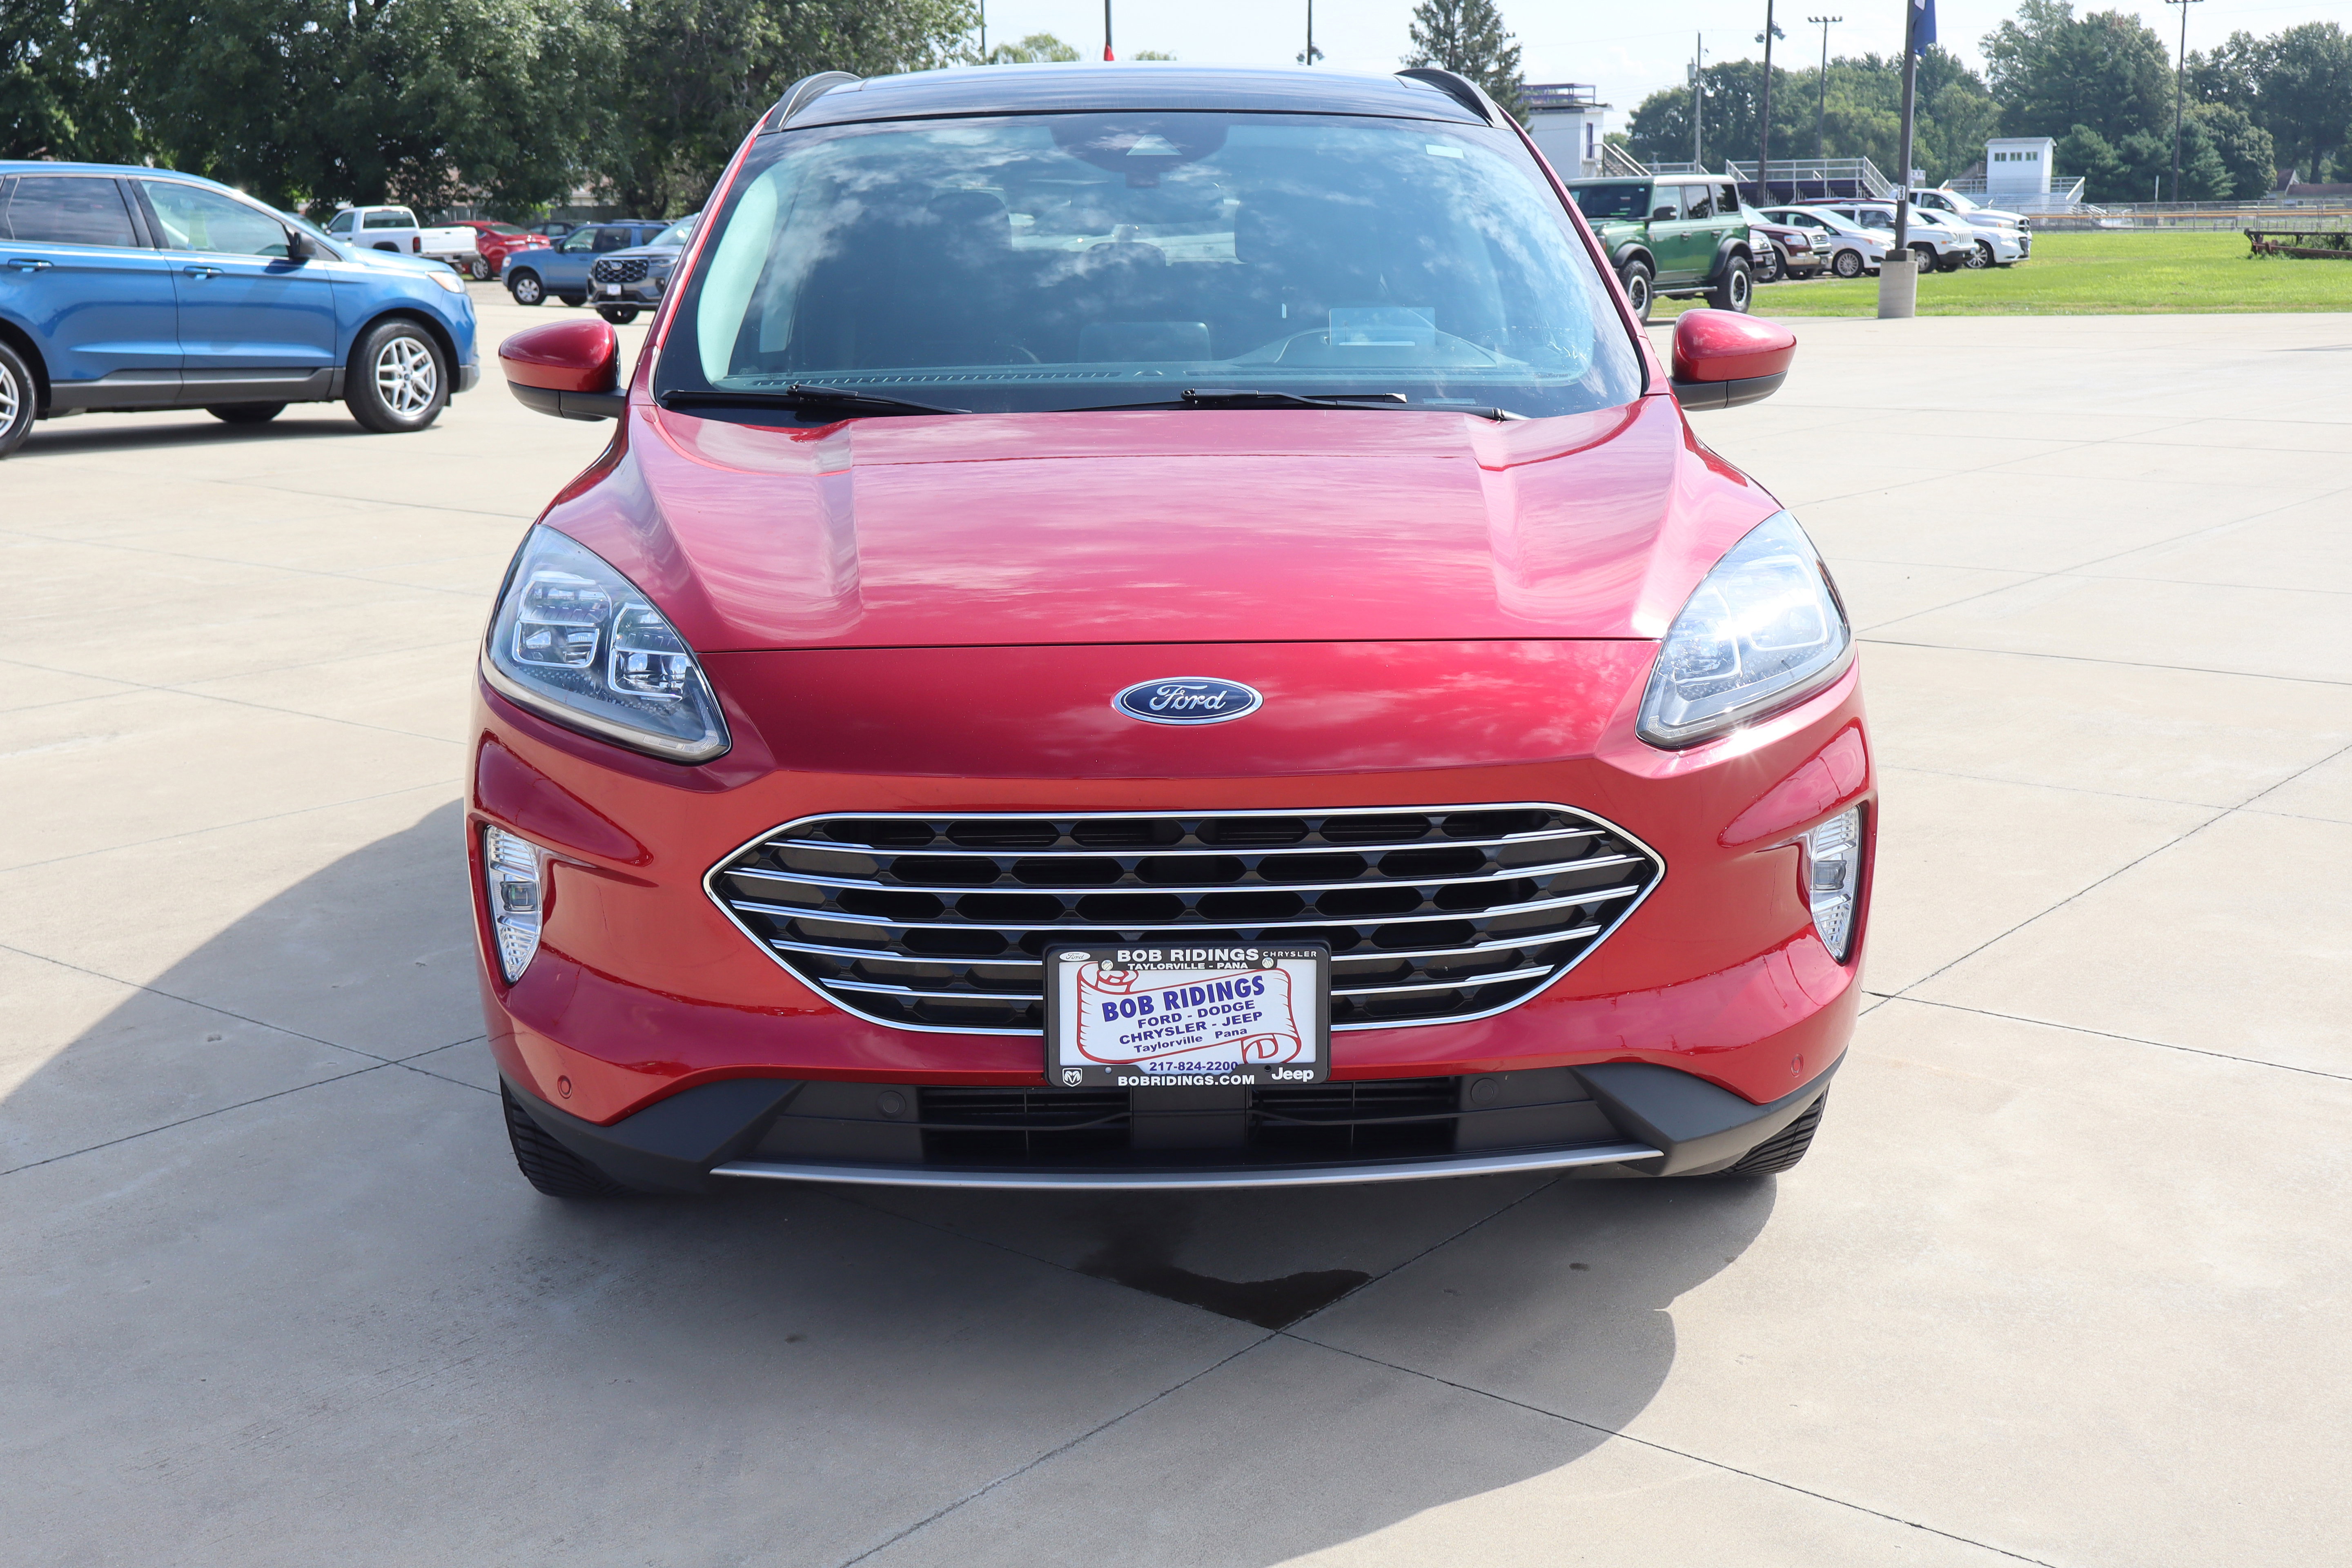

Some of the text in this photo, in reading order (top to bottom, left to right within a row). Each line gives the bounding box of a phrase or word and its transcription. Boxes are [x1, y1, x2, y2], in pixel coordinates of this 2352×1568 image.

[1149, 685, 1227, 710] Ford
[1117, 948, 1259, 962] BOB RIDINGS
[1102, 975, 1265, 1022] BOB RIDINGS
[1138, 1013, 1182, 1029] FORD
[1197, 1000, 1255, 1018] DODGE
[1119, 1021, 1207, 1044] CHRYSLER
[1222, 1011, 1263, 1026] JEEP
[1134, 1028, 1247, 1053] Taylorville Pana
[1149, 1061, 1238, 1071] 217-824-2200
[1271, 1067, 1314, 1082] Jeep
[1118, 1075, 1255, 1086] BOBRIDINGS.COM
